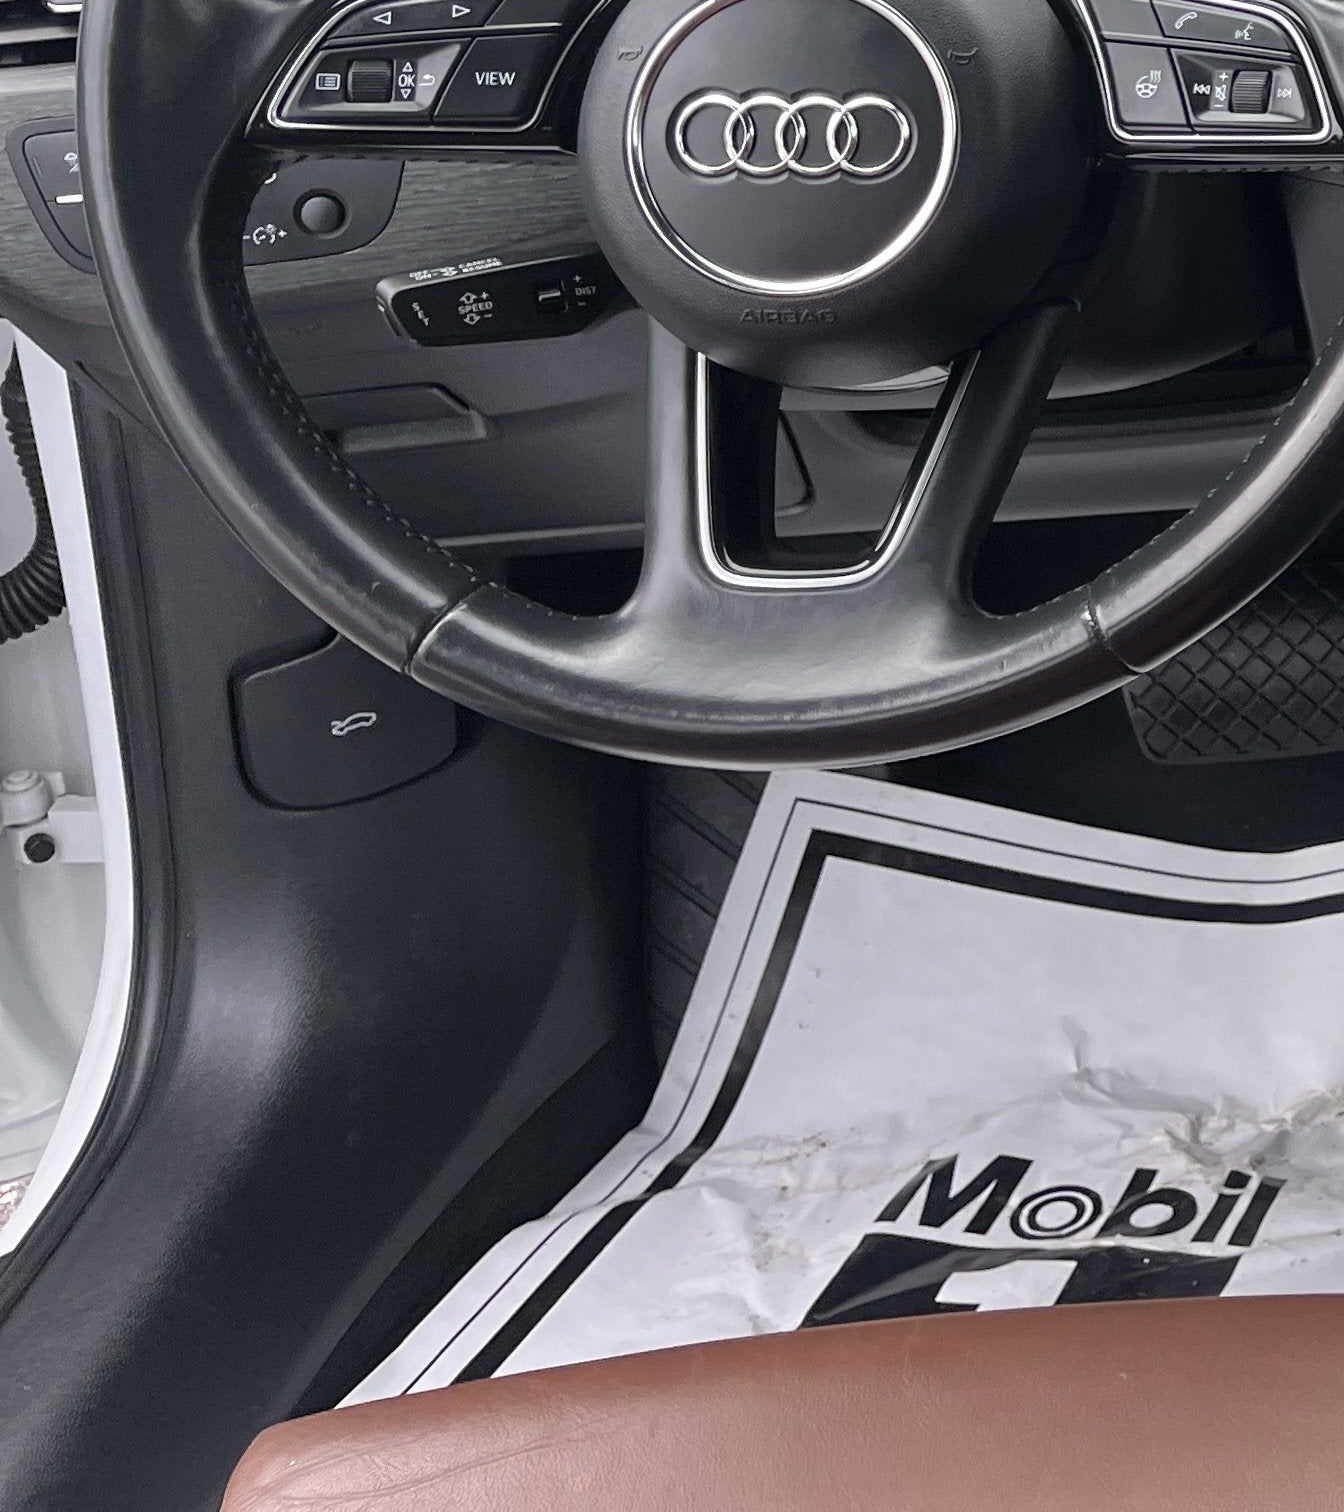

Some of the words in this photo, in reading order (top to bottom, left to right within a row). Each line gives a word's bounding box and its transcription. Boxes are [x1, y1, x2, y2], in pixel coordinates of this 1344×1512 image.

[398, 73, 416, 88] OK
[474, 71, 516, 86] VIEW
[457, 301, 494, 316] SPEED
[875, 1153, 1287, 1247] Mobil
